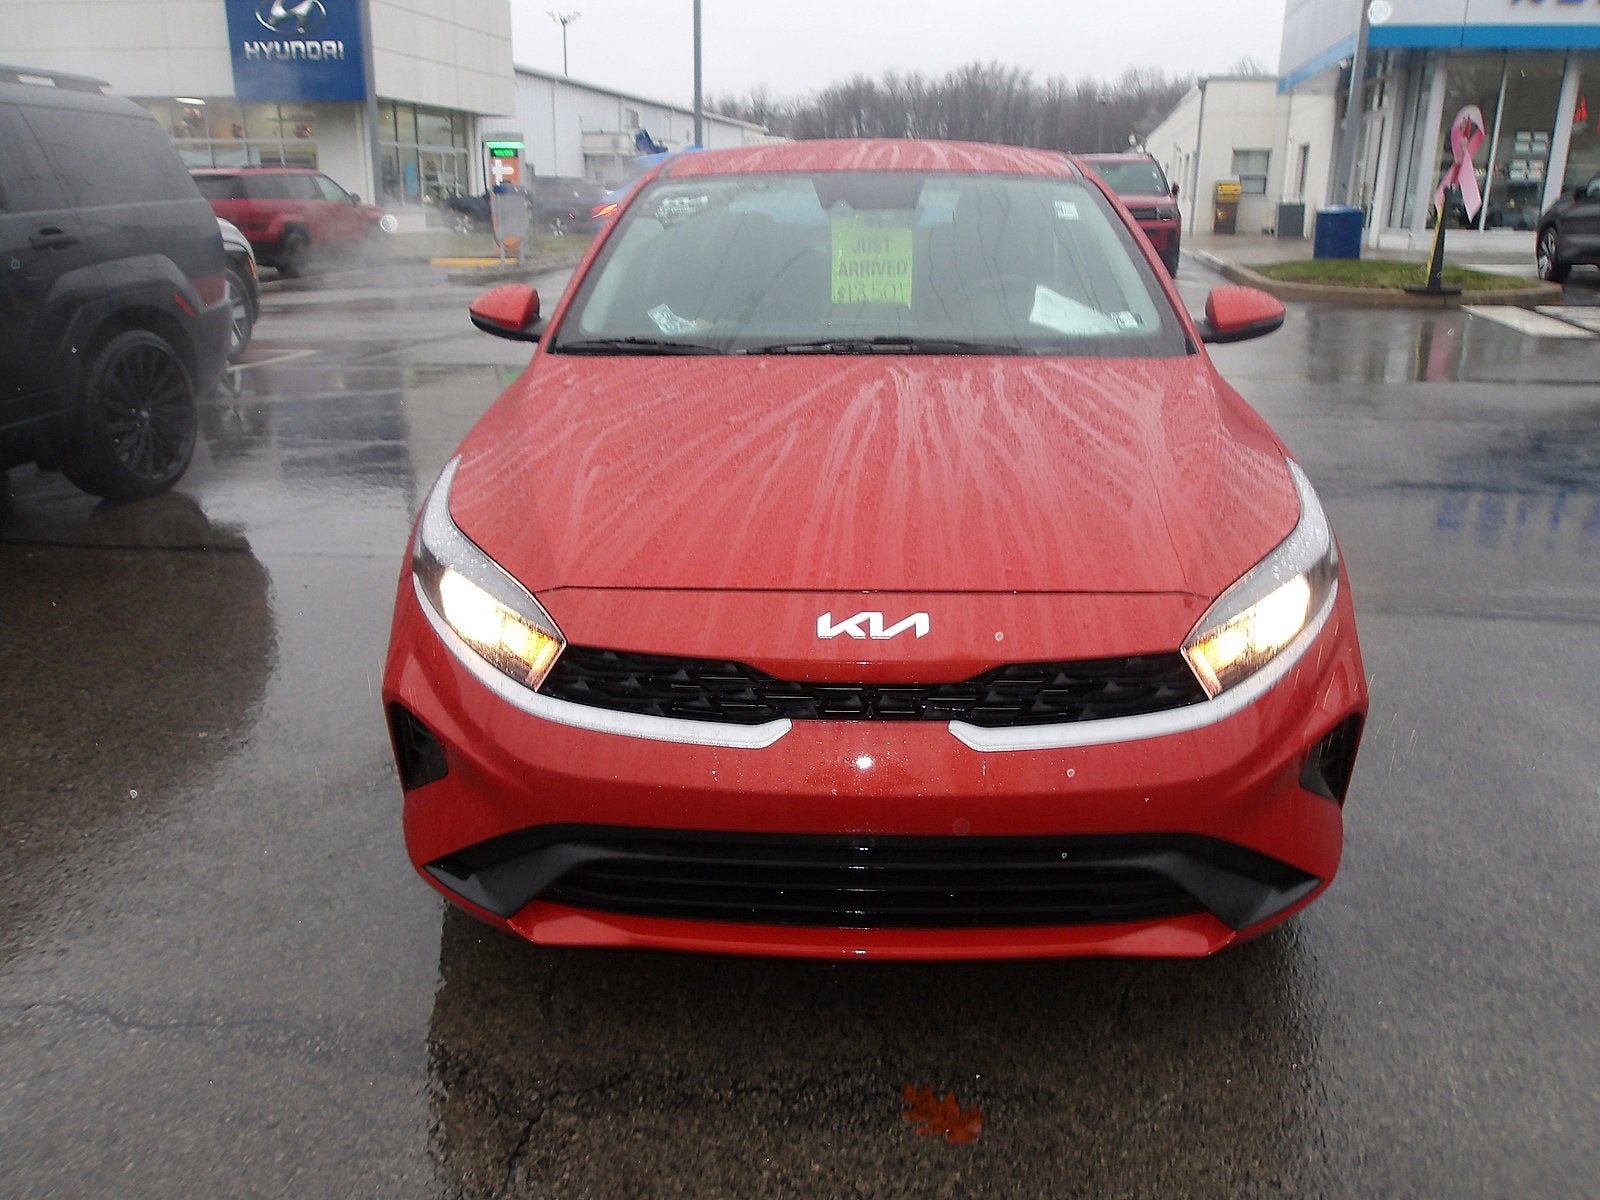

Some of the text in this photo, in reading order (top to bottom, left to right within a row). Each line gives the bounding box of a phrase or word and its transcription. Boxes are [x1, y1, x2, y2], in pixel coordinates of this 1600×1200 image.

[244, 40, 344, 60] HYUNDAI
[852, 236, 891, 253] JUST
[839, 259, 908, 277] ARRIVED
[817, 611, 929, 639] KIA
